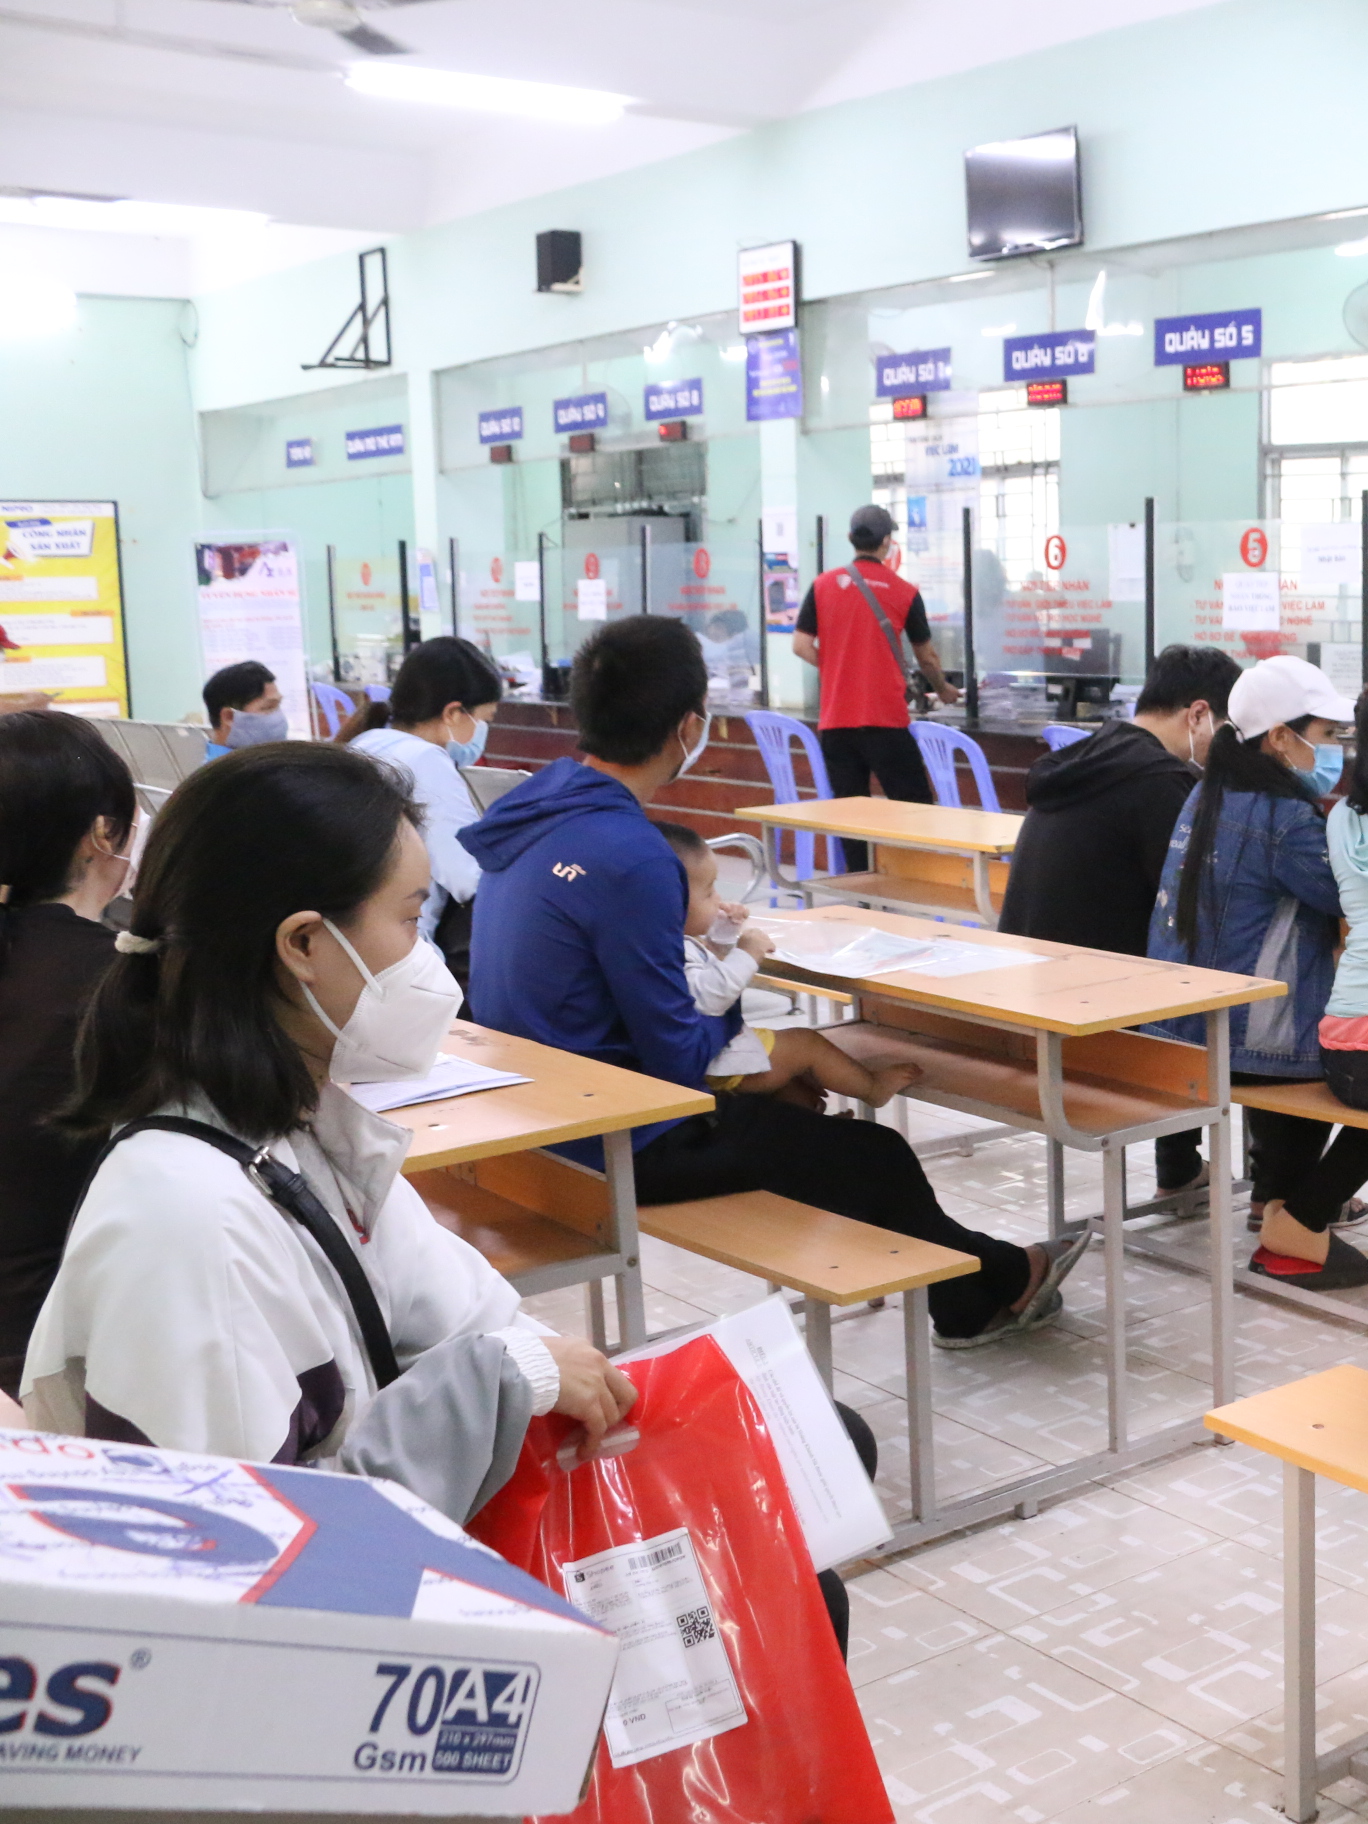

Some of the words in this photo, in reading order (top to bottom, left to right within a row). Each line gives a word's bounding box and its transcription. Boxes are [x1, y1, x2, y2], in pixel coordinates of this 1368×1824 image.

[1213, 320, 1238, 349] SỐ
[1241, 324, 1254, 346] 5
[948, 456, 975, 476] 2021
[1048, 538, 1063, 567] 6
[369, 1662, 446, 1737] 70
[443, 1668, 531, 1726] A4
[65, 1744, 142, 1763] MONEY
[354, 1741, 428, 1773] Gsm
[462, 1752, 512, 1767] SHEET
